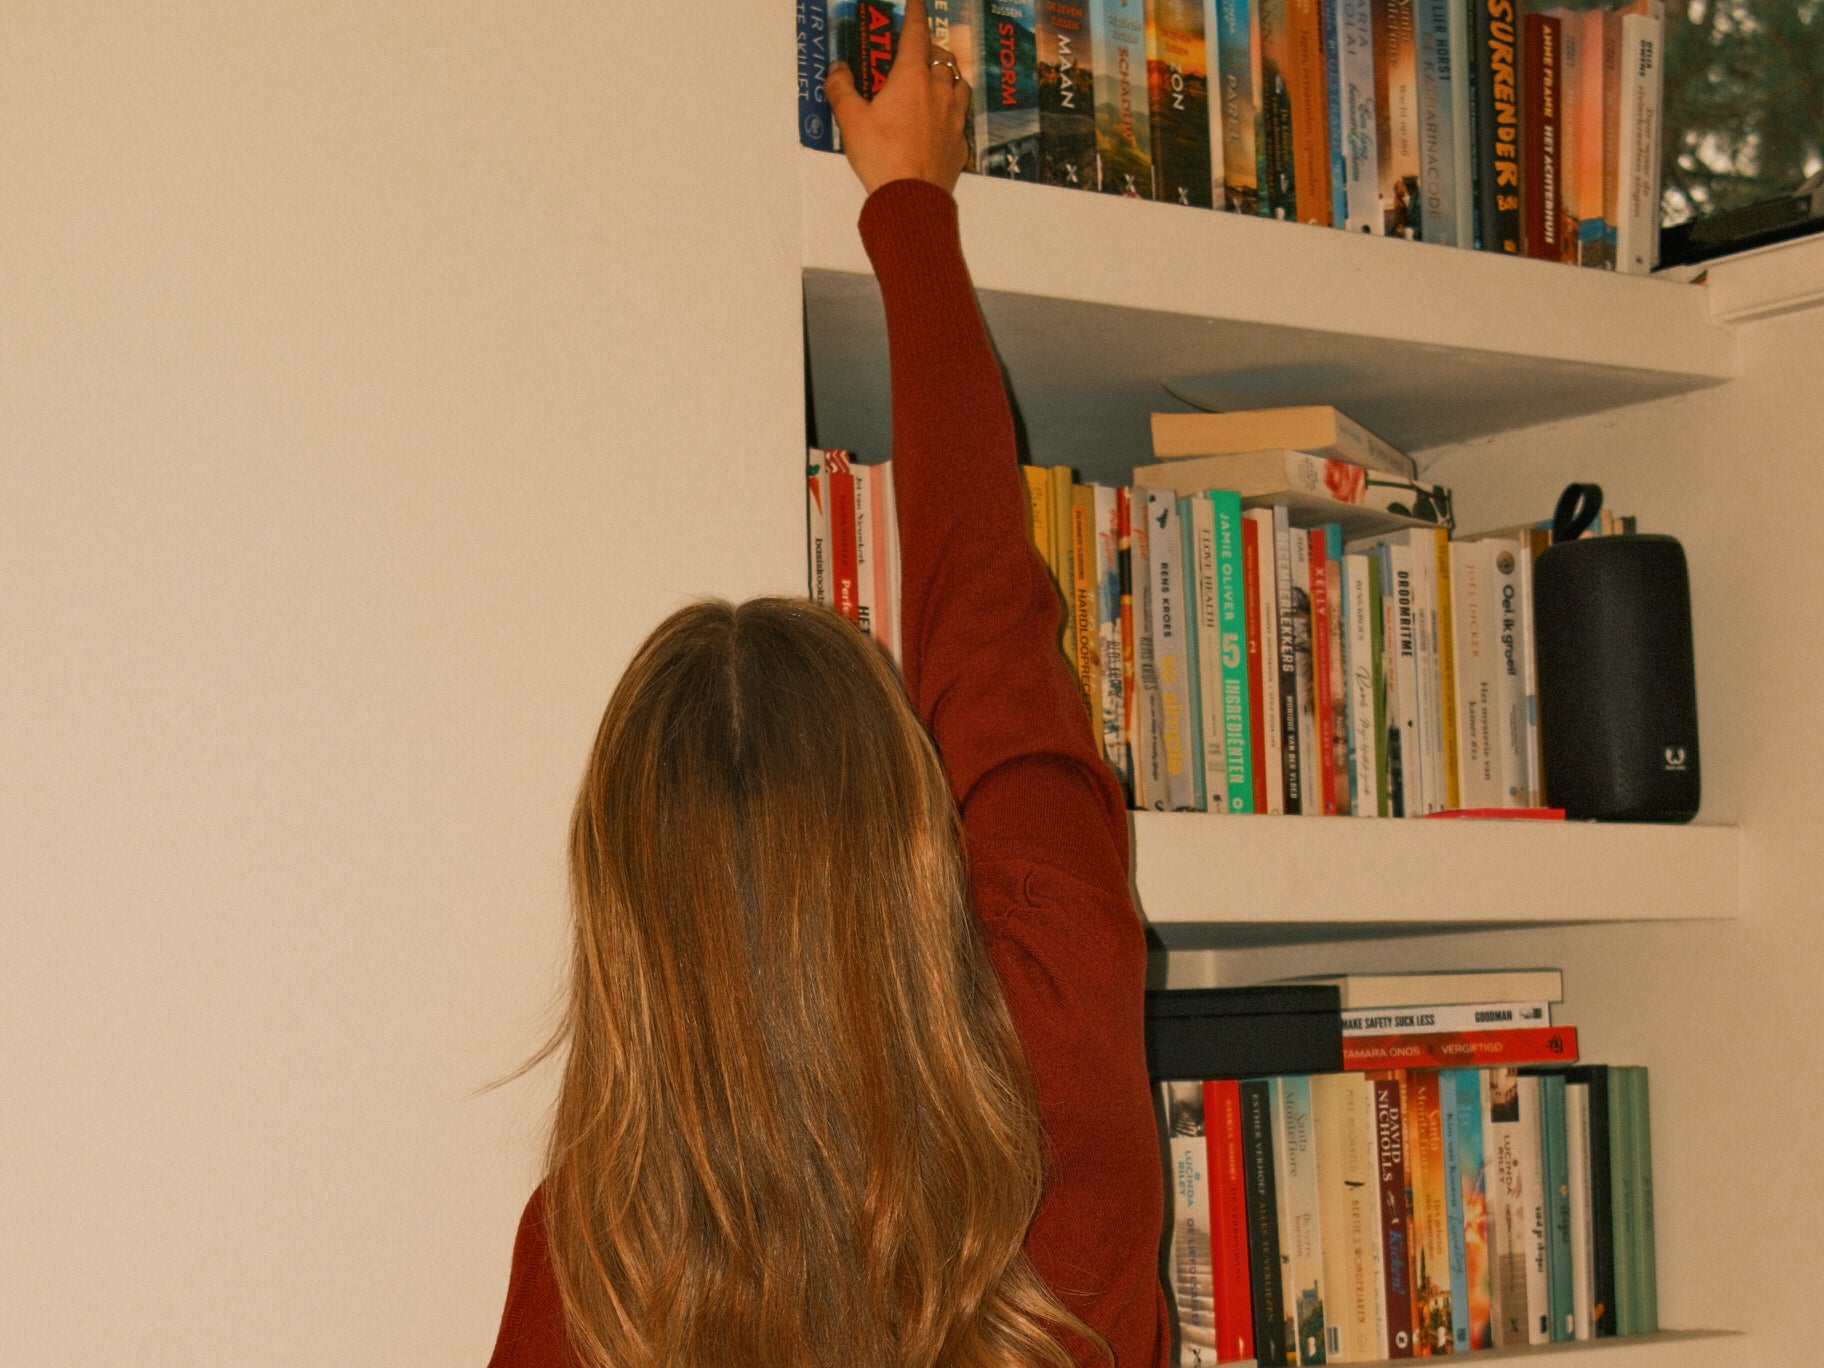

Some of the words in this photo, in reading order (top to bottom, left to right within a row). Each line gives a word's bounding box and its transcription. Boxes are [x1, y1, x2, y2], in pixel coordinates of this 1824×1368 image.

[935, 16, 950, 53] ZEV
[1357, 0, 1367, 48] ARIA
[1433, 6, 1448, 33] LIER
[811, 6, 826, 103] IRVING
[869, 5, 891, 93] ATLA
[998, 22, 1017, 106] STORM
[1436, 40, 1451, 81] HORST
[1543, 25, 1554, 67] ANNE
[1639, 39, 1647, 78] OWENS
[1058, 34, 1074, 109] MAAN
[1170, 61, 1185, 111] ZON
[1117, 46, 1135, 148] SCHADUW
[1226, 74, 1240, 143] PAREL
[1487, 0, 1518, 187] SURRENDER
[1543, 69, 1554, 118] FRANK
[1422, 62, 1441, 221] KATHARINACODE
[1543, 125, 1554, 153] HET
[1543, 155, 1555, 244] ACHTERHUIS
[1220, 512, 1232, 559] JAMIE
[815, 537, 824, 607] basiskookb
[1160, 563, 1170, 594] RENS
[1222, 562, 1235, 621] OLIVER
[840, 579, 852, 613] Perfe
[1204, 576, 1216, 628] HEALTH
[1277, 531, 1294, 673] DECEMBERLEKKERS
[1398, 571, 1413, 658] DROOMRITME
[1161, 598, 1172, 638] KROES
[1469, 603, 1480, 659] DICKER
[1503, 618, 1516, 633] ik
[1160, 654, 1178, 684] so
[1223, 632, 1241, 668] 5
[1286, 695, 1295, 732] MONIQUE
[1480, 681, 1490, 705] Het
[1160, 691, 1186, 775] simple
[1224, 678, 1245, 783] INGREDIËNTEN
[1468, 700, 1478, 737] kamer
[1480, 707, 1491, 757] mysterie
[1287, 734, 1296, 751] VAN
[1288, 753, 1297, 770] DER
[1483, 760, 1491, 781] van
[1341, 1018, 1362, 1030] MAKE
[1364, 1016, 1392, 1029] SAFETY
[1394, 1015, 1415, 1027] SUCK
[1416, 1014, 1435, 1026] LESS
[1474, 1010, 1513, 1023] GOODMAN
[1342, 1047, 1387, 1059] TAMARA
[1440, 1042, 1503, 1055] VERGIFTIGD
[1225, 1099, 1234, 1139] SASKIA
[1252, 1093, 1263, 1138] ESTHER
[1286, 1091, 1300, 1178] Montefiore
[1295, 1112, 1309, 1153] Santa
[1378, 1089, 1397, 1182] NICHOLLS
[1388, 1107, 1401, 1164] DAVID
[1446, 1112, 1455, 1137] Kim
[1228, 1143, 1237, 1181] NOORT
[1447, 1140, 1456, 1162] van
[1497, 1146, 1505, 1185] RILEY
[1503, 1134, 1514, 1195] LUCINDA
[1177, 1161, 1186, 1197] RILEY
[1184, 1149, 1194, 1208] LUCINDA
[1449, 1165, 1458, 1208] Kooten
[1186, 1217, 1195, 1235] DE
[1258, 1202, 1268, 1240] ALLES
[1261, 1261, 1274, 1323] VERLIEZEN
